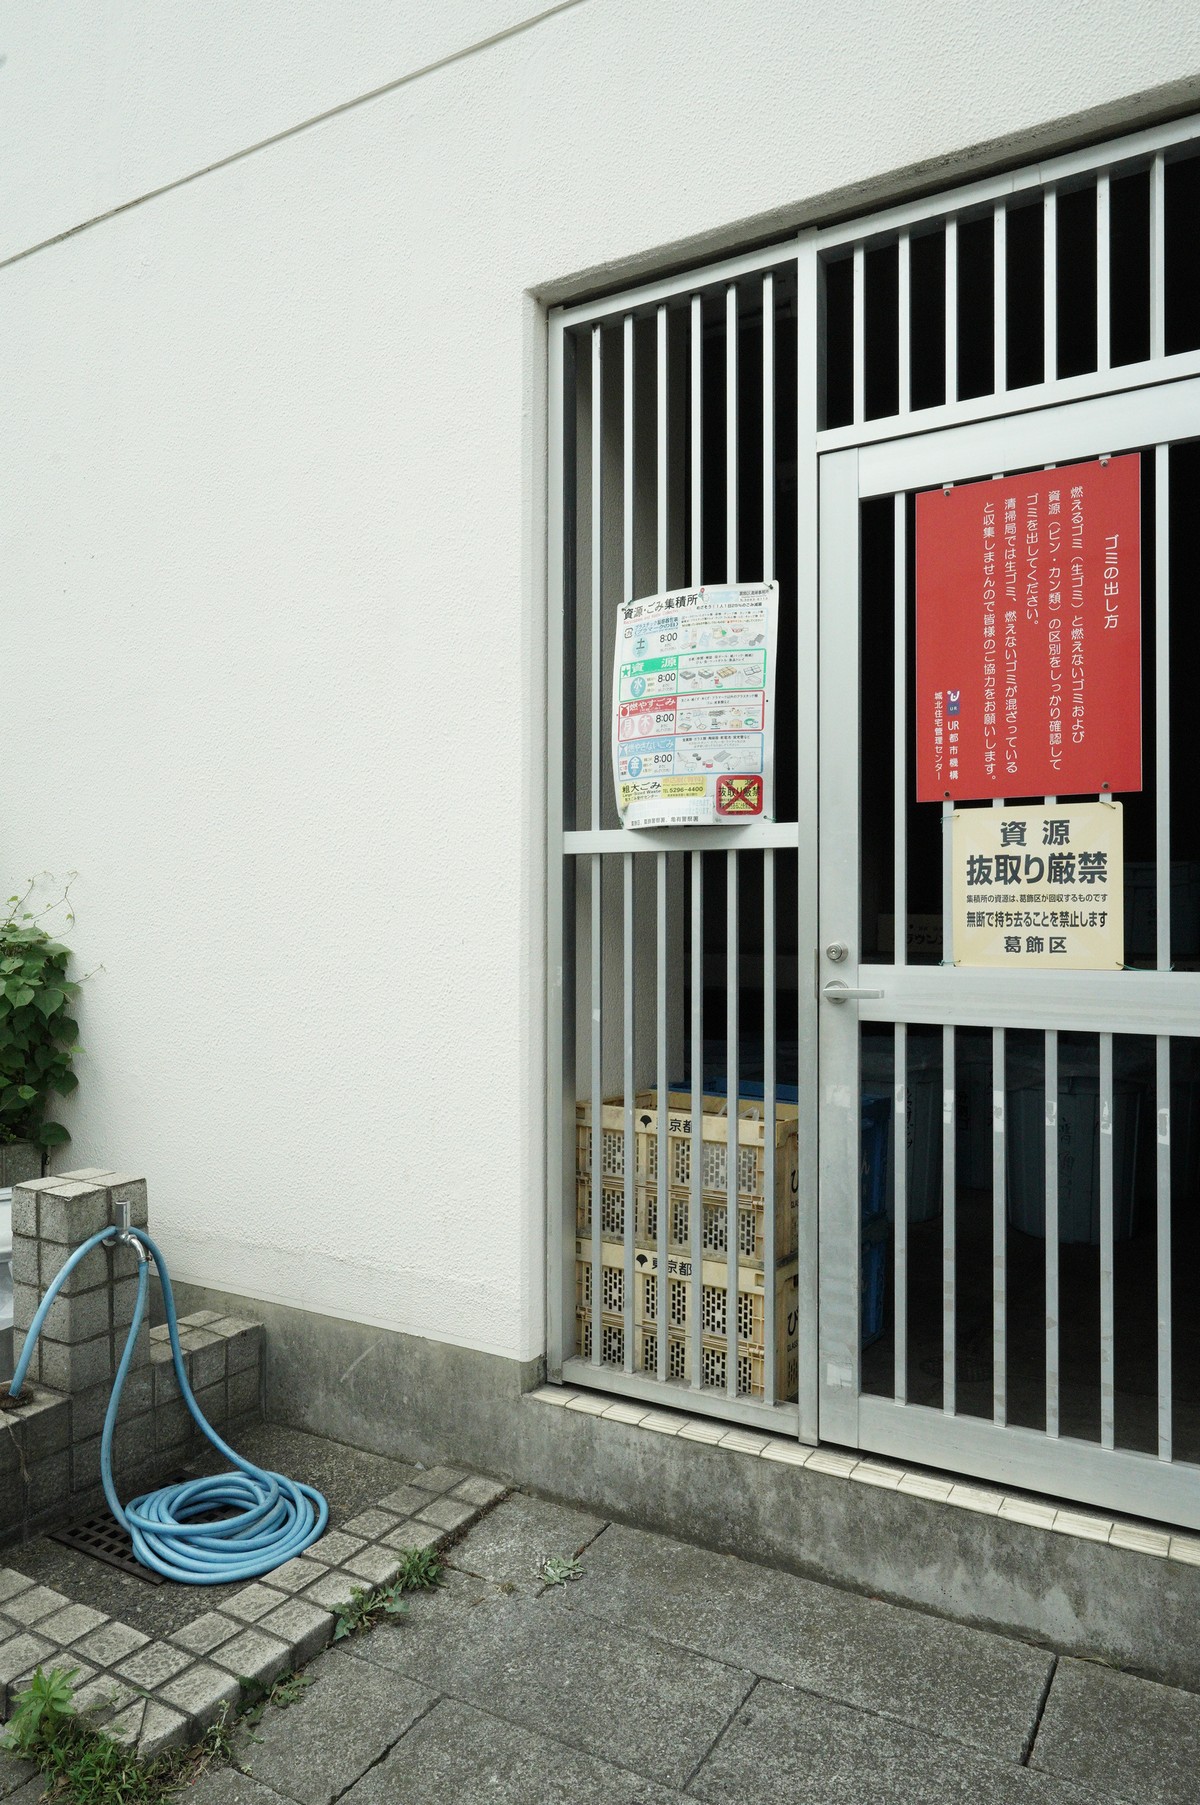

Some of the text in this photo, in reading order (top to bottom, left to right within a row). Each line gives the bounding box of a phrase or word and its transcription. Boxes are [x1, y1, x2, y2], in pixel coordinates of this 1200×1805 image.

[1026, 493, 1039, 625] ゴミを出してください。
[1103, 533, 1119, 629] ゴミの出し方
[623, 593, 698, 620] 資源・ごみ集積所
[659, 632, 678, 643] 8:00
[983, 501, 996, 780] と収集しませんので皆様のご協力をお願いします。
[1004, 497, 1018, 773] 清掃局では生ゴミ、燃えないゴミが混ざっている
[657, 672, 676, 683] 8:00
[655, 713, 674, 723] 8:00
[653, 753, 673, 764] 8:00
[621, 781, 661, 794] 粗大ごみ
[1001, 819, 1070, 848] 資源
[966, 851, 1108, 886] 抜取り厳禁
[966, 893, 1108, 904] 集積所の資源は、葛飾区が回収するものです
[966, 910, 1108, 928] 無断で持ち去ることを禁止します
[1003, 935, 1068, 954] 葛飾区
[656, 1117, 692, 1134] 京都
